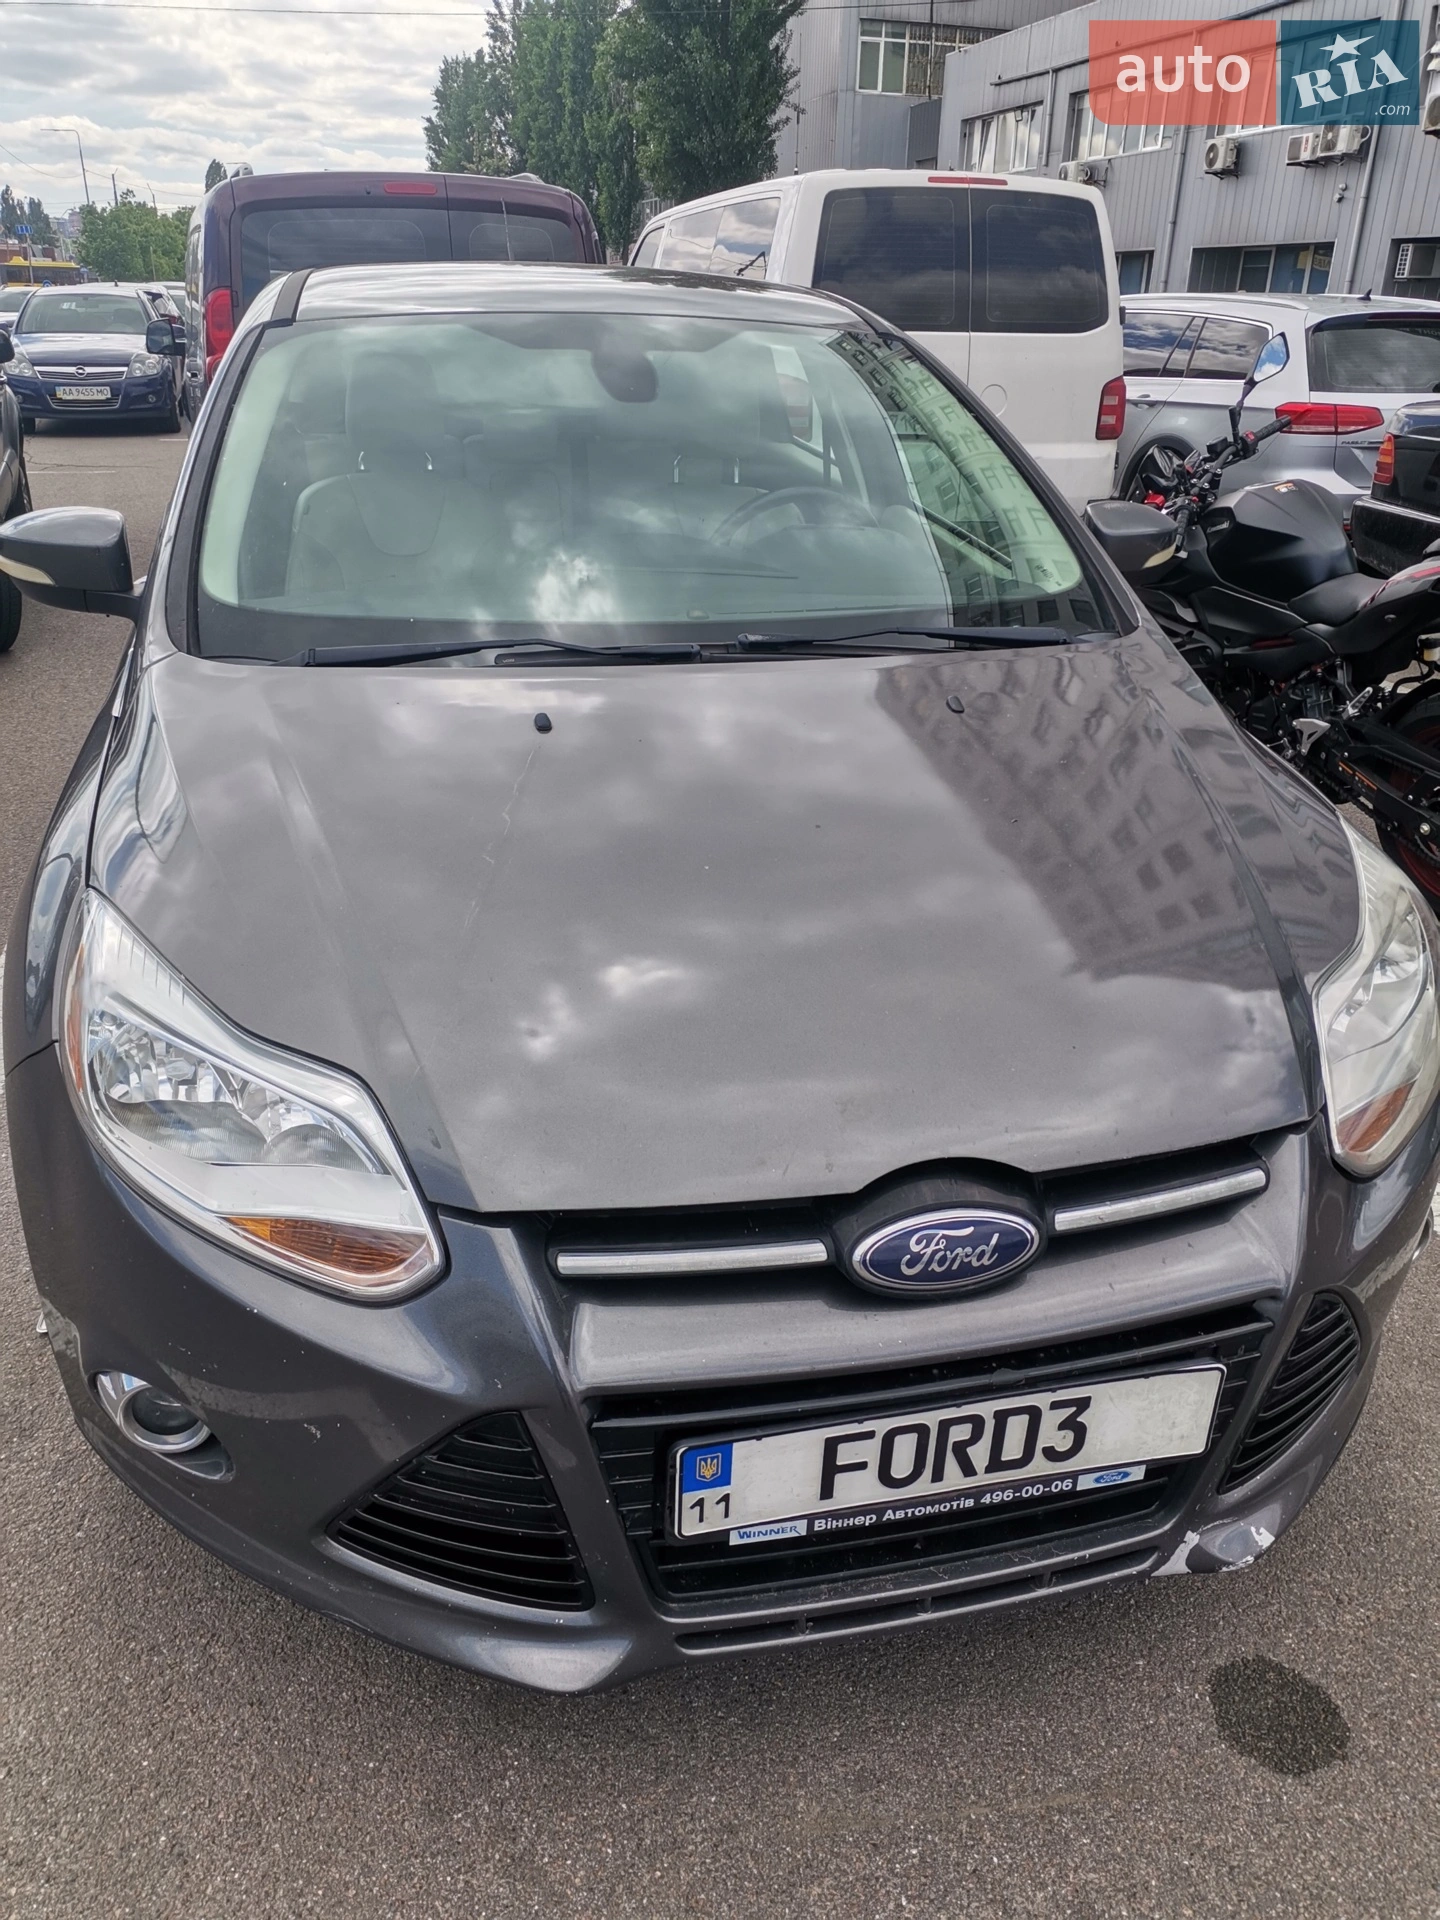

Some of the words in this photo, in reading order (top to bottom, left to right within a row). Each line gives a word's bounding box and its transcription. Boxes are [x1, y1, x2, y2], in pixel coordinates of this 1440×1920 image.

[62, 388, 74, 397] AA
[75, 388, 95, 397] 9455
[96, 388, 109, 397] MO
[900, 1226, 1000, 1276] Ford
[819, 1395, 1093, 1501] FORD3
[1100, 1472, 1124, 1483] Ford
[689, 1492, 731, 1524] 11
[813, 1514, 877, 1532] Віннер
[882, 1497, 975, 1522] Автомотів
[980, 1478, 1073, 1505] 496-00-06
[737, 1525, 801, 1540] WINNER
